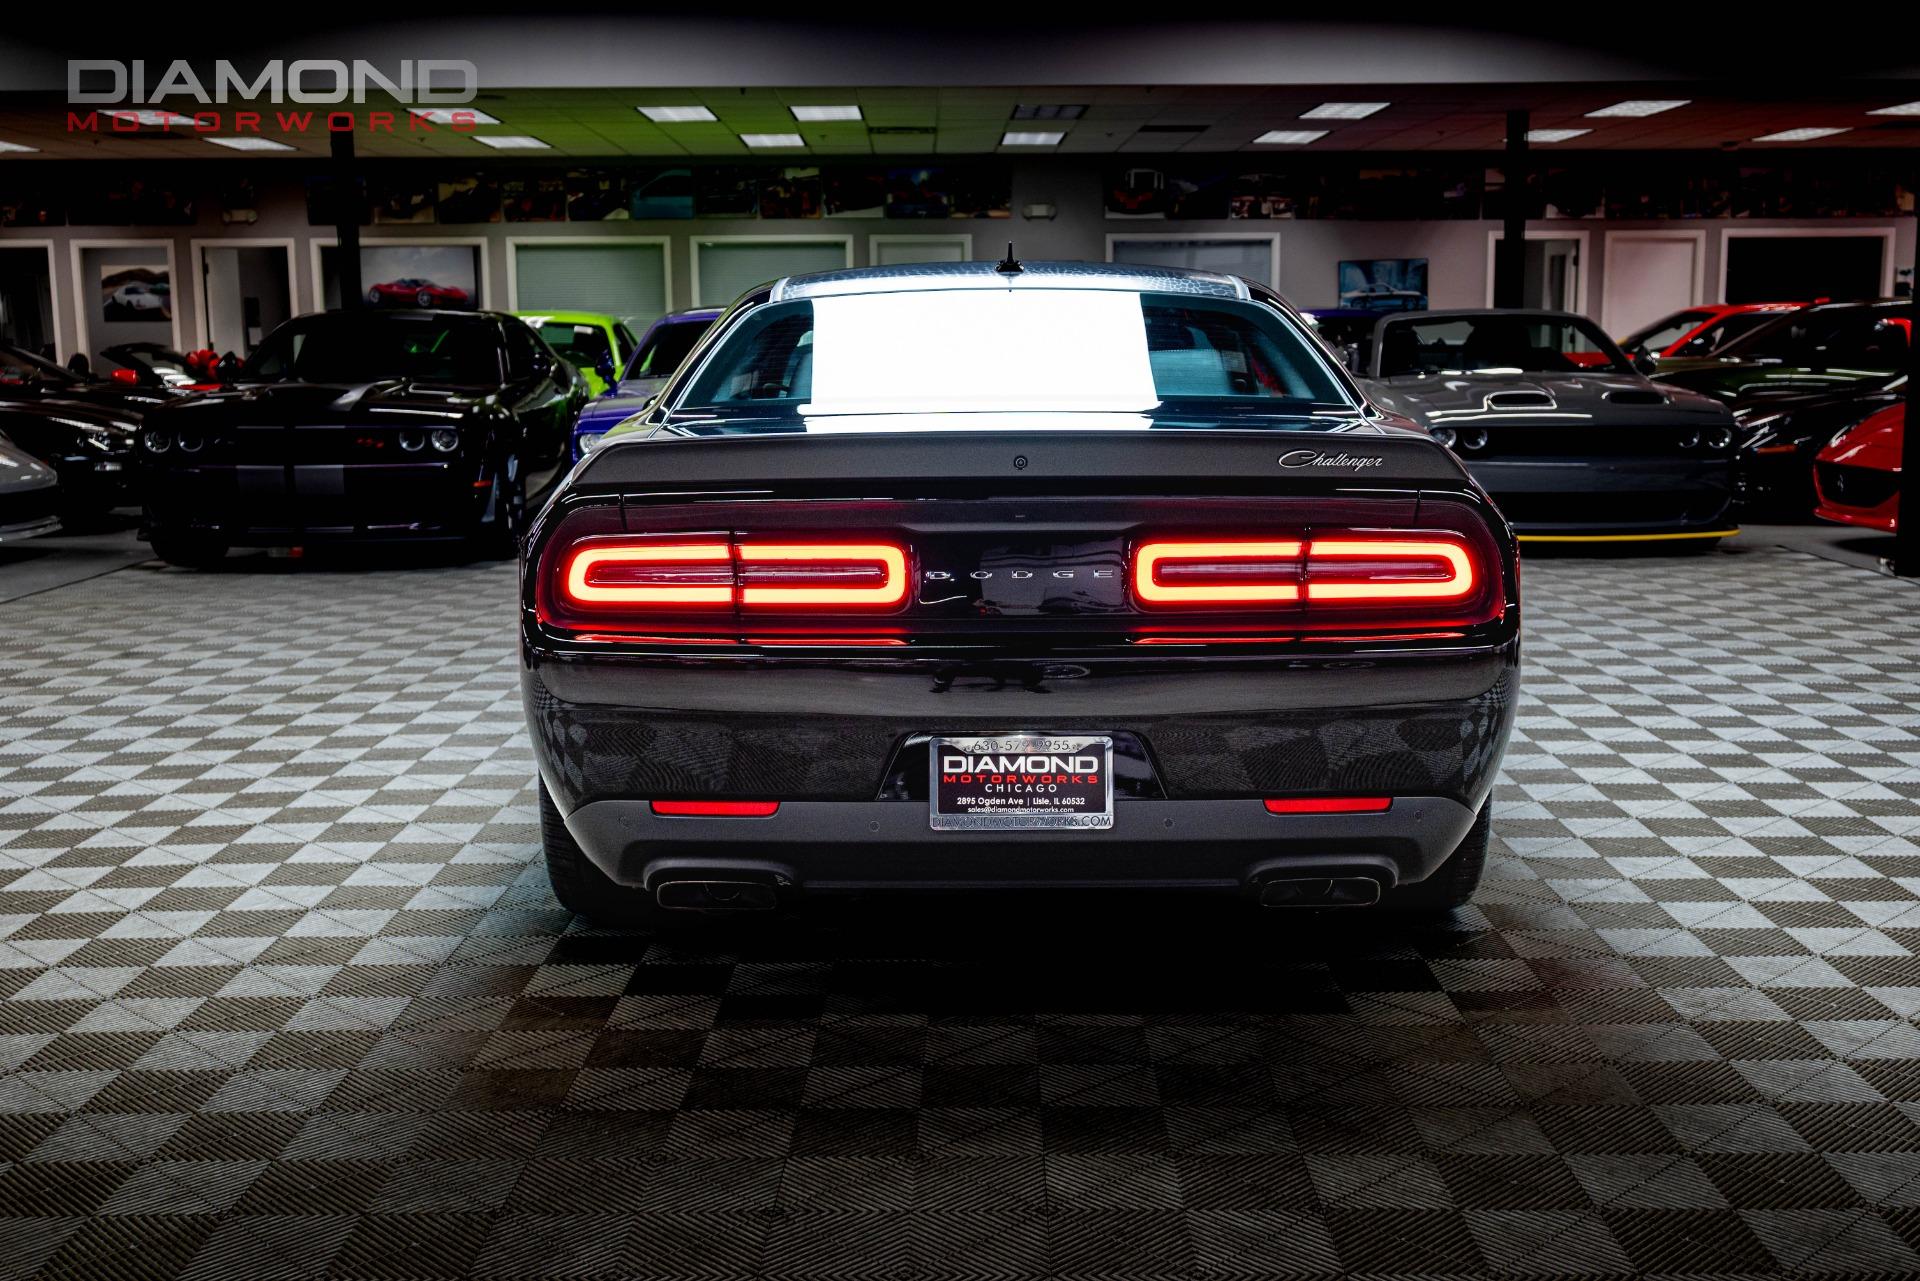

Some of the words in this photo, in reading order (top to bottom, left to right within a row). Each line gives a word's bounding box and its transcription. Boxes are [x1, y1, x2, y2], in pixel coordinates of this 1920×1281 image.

[1279, 450, 1383, 471] Challenger
[926, 570, 1113, 580] DODGE
[943, 756, 1099, 773] DIAMOND
[943, 775, 1098, 784] MOTORWORKS
[985, 784, 1058, 793] CHICAGO
[957, 797, 976, 805] 2895
[978, 797, 1005, 806] Ogden
[1007, 797, 1024, 805] Ave
[1054, 797, 1061, 805] IL
[1062, 797, 1086, 805] 60532
[967, 806, 1075, 814] sales@diamondmotorworks.com
